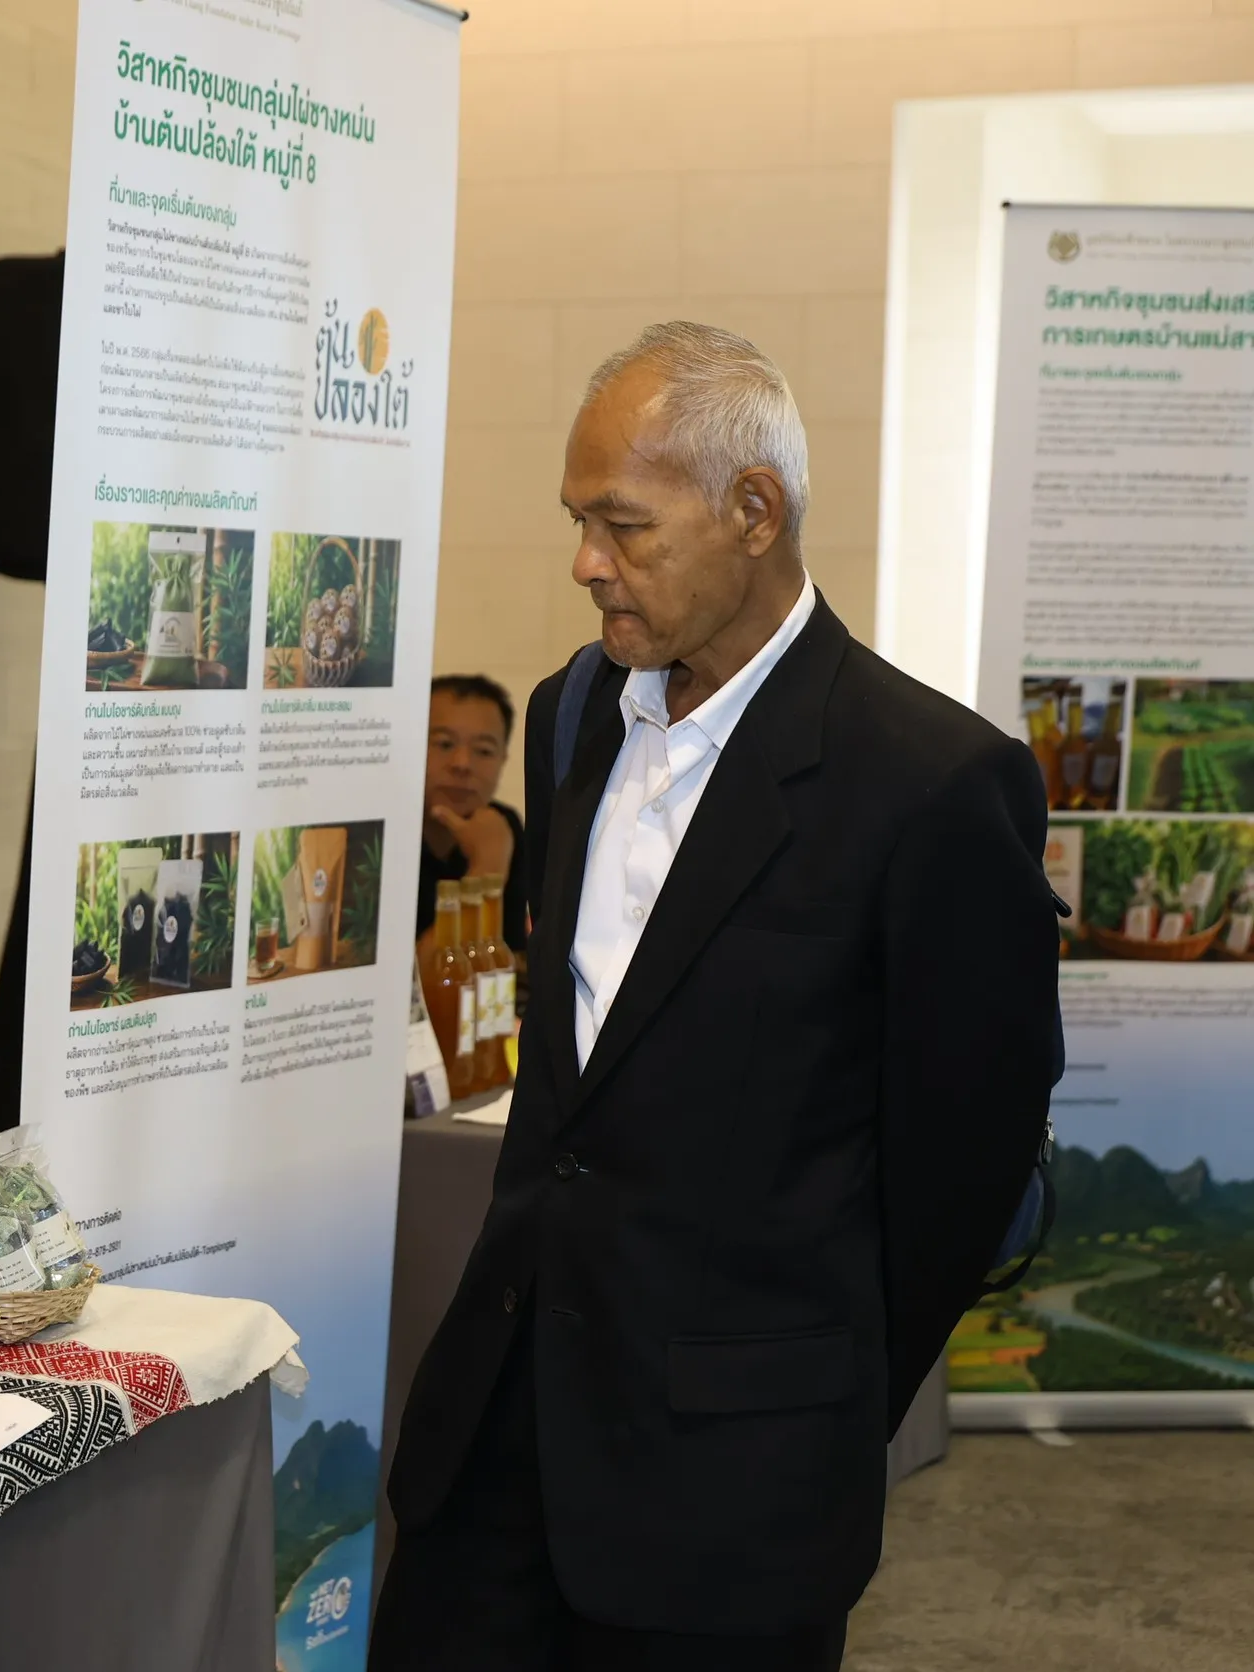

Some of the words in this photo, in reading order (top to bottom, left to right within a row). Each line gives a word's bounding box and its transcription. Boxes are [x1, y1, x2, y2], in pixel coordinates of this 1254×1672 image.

[117, 40, 375, 144] วิสาหกิจชุมชนกลุ่มไผ่ซางหม่น
[114, 98, 256, 170] บ้านต้นปล้องใต้
[263, 133, 303, 190] หมู่ที่
[306, 154, 317, 184] 8
[109, 175, 237, 231] ที่มาและจุดเริ่มต้นของกลุ่ม
[94, 474, 258, 512] เรื่องราวและคุณค่าของผลิตภัณฑ์
